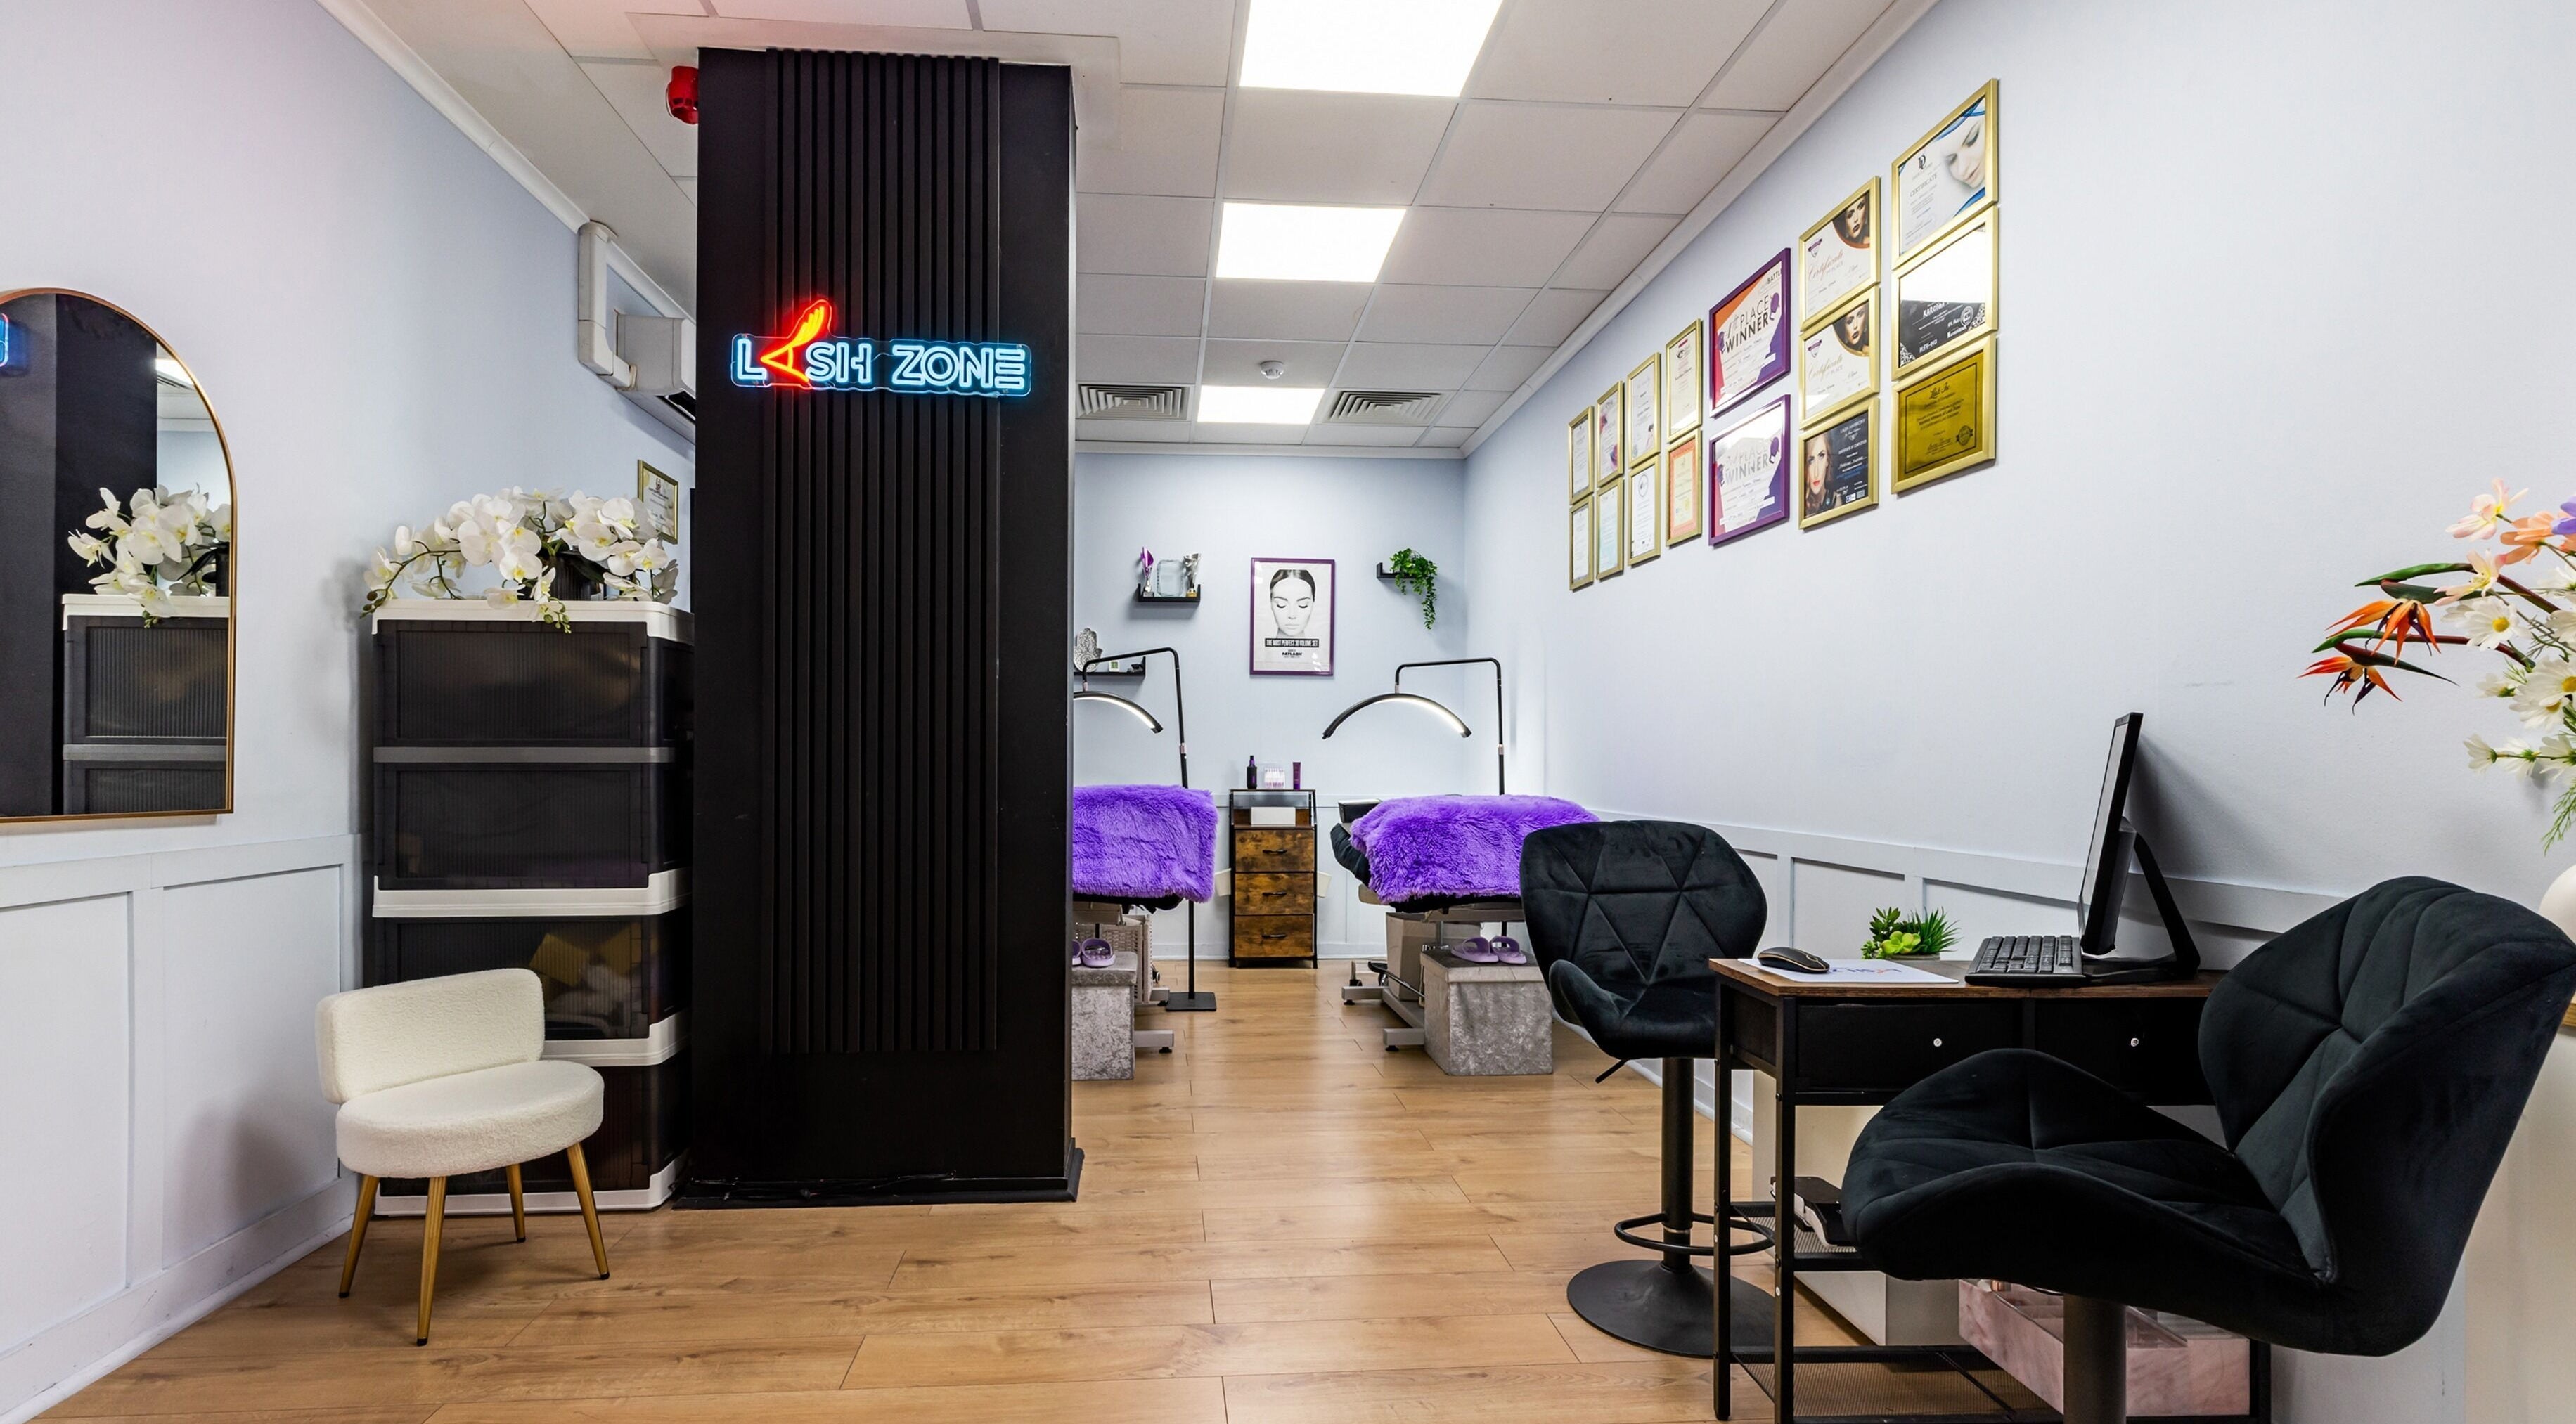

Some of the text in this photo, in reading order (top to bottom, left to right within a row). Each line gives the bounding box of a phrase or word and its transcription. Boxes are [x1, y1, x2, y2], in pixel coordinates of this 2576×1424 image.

[1767, 269, 1782, 285] BATTL
[1740, 294, 1769, 325] PLACE
[736, 305, 1026, 389] LASH ZONE
[1725, 312, 1769, 353] WINNER
[1725, 452, 1769, 485] WINNER
